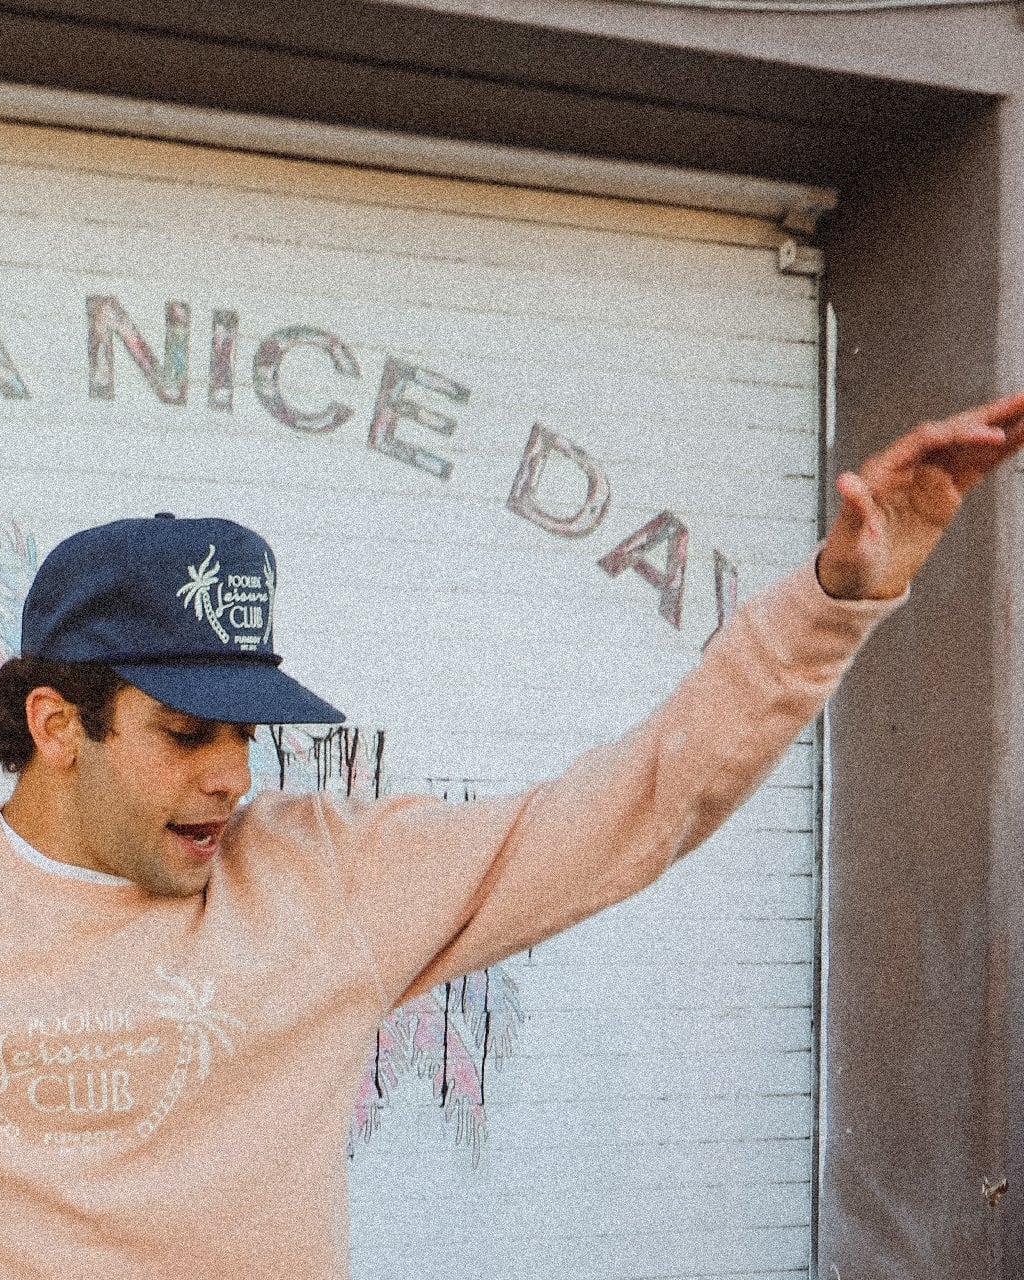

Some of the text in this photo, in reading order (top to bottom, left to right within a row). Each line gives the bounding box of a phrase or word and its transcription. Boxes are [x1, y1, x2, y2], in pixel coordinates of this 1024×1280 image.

[85, 294, 472, 481] NICE
[229, 605, 264, 629] CLUB
[27, 1068, 135, 1114] CLUB
